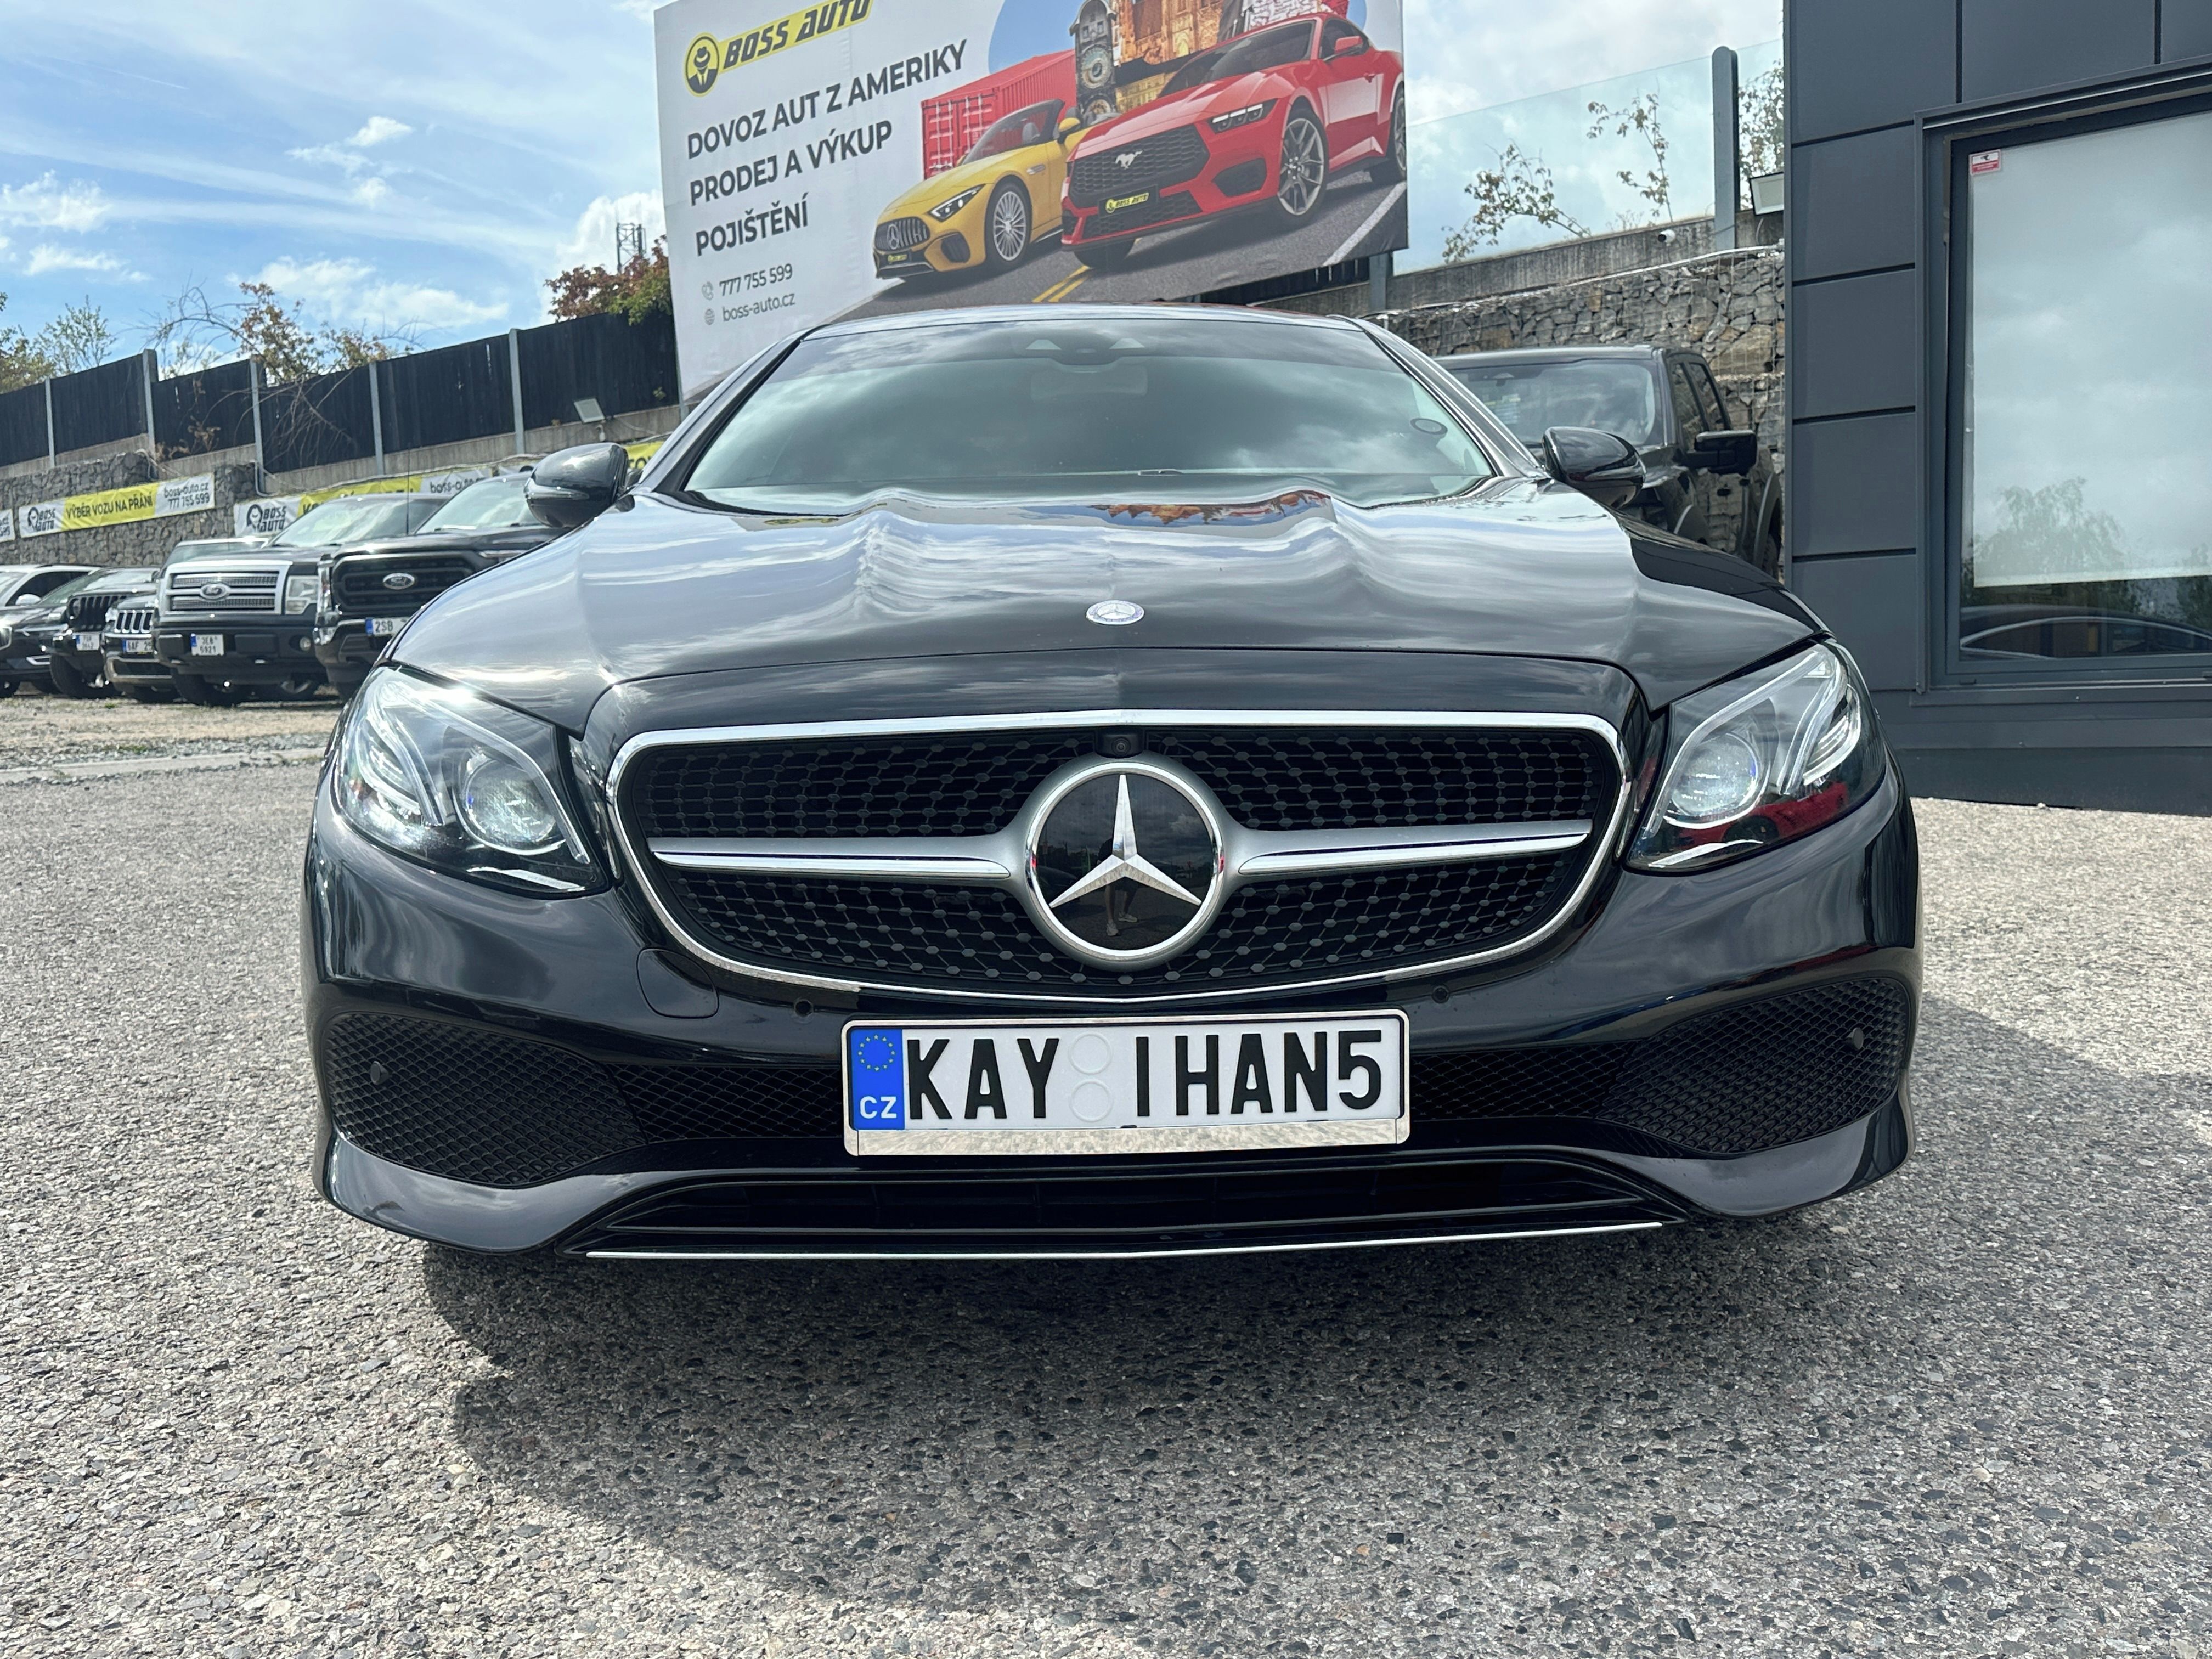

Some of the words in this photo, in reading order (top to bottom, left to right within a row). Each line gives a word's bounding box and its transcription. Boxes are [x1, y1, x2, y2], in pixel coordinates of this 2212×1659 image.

[723, 20, 790, 69] BOSS
[795, 0, 870, 42] AUTO
[687, 109, 767, 159] DOVOZ
[772, 90, 820, 132] AUT
[826, 83, 842, 114] Z
[848, 39, 967, 107] AMERIKY
[690, 155, 777, 206] PRODEJ
[785, 149, 803, 178] A
[806, 120, 892, 169] VÝKUP
[696, 192, 809, 257] POJIŠTĚNÍ
[719, 276, 741, 296] 777
[744, 270, 767, 290] 755
[769, 263, 793, 284] 599
[723, 293, 795, 321] boss-auto.cz
[115, 500, 127, 511] NA
[168, 498, 180, 509] 777
[263, 505, 286, 519] BOSS
[259, 518, 285, 533] AUTO
[907, 1038, 1060, 1119] KAY
[1136, 1029, 1382, 1118] IHAN5
[860, 1096, 897, 1119] CZ
